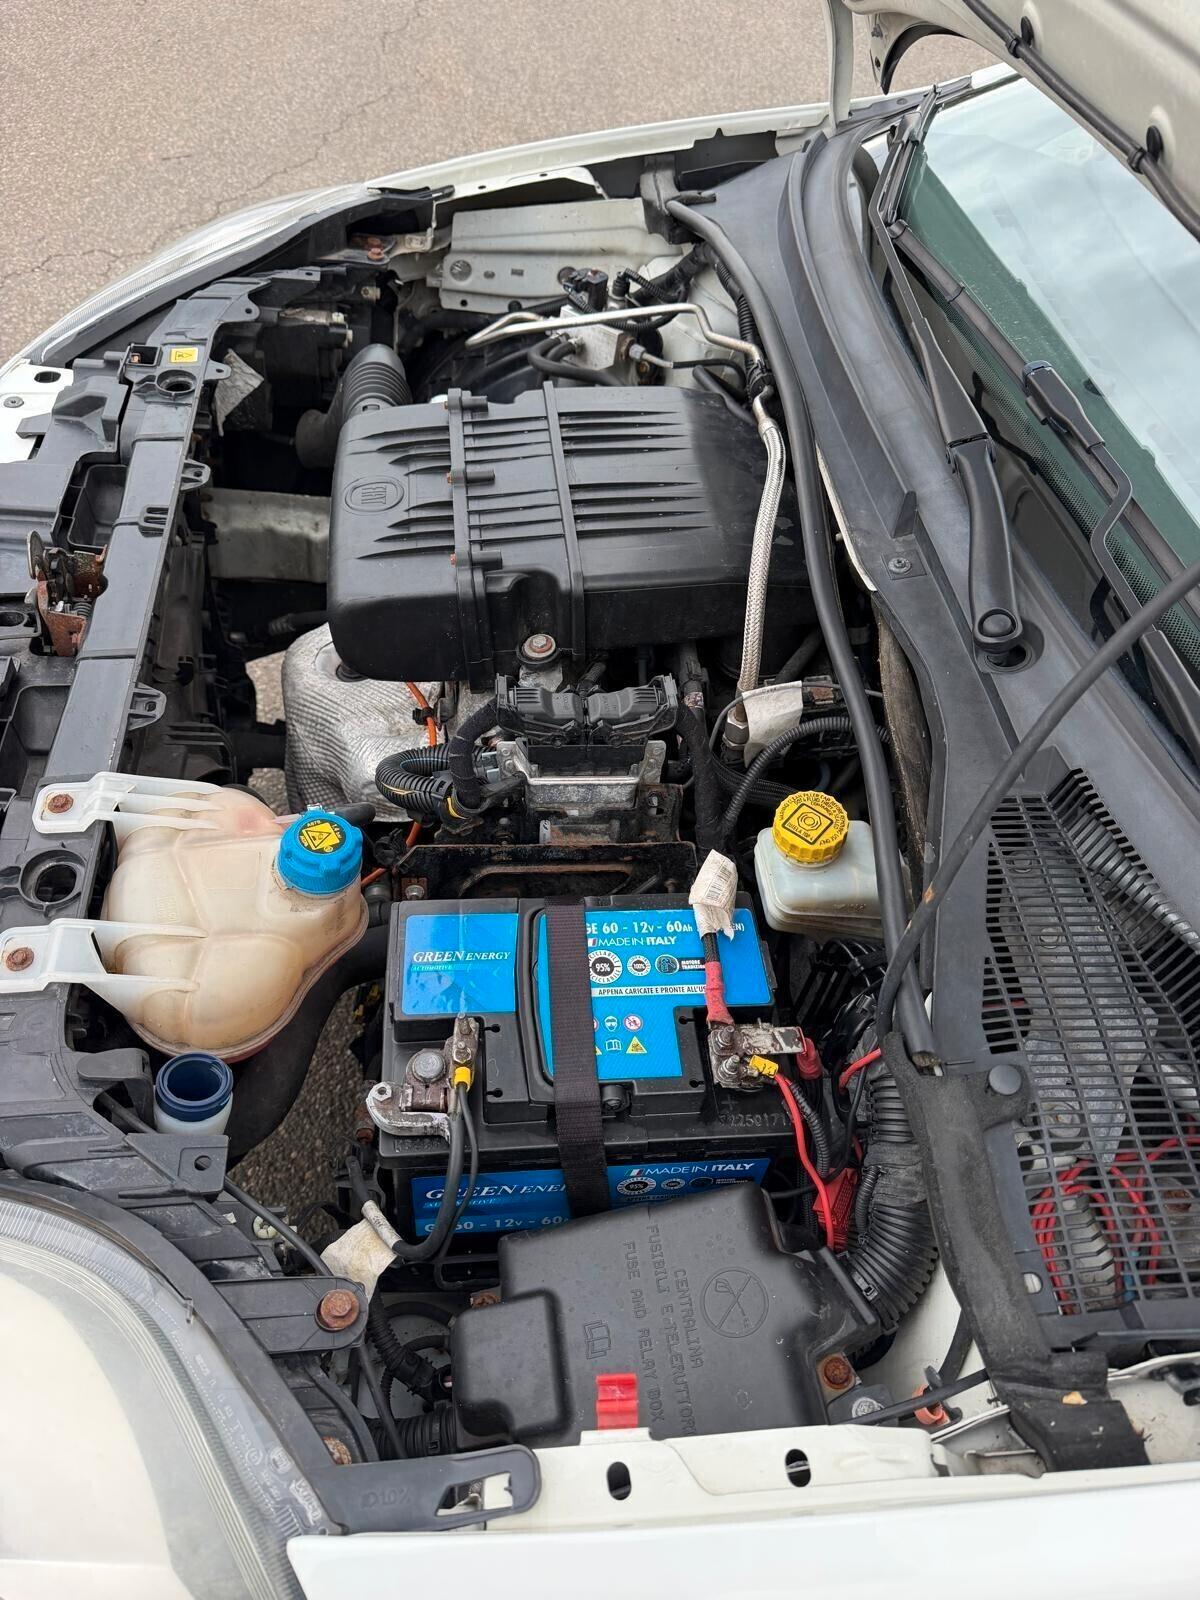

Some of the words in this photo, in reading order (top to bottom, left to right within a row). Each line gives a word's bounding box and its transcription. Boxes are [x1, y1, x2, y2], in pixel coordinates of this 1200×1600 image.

[602, 922, 619, 934] 60
[666, 920, 693, 933] 60Ah
[598, 937, 632, 947] MADE
[631, 936, 644, 947] IN
[646, 936, 677, 946] ITALY
[413, 950, 465, 963] GREEN
[465, 951, 511, 961] ENERGY
[595, 963, 611, 972] 95%
[598, 988, 624, 996] APPENA
[624, 987, 654, 995] CARICATE
[655, 986, 660, 995] E
[660, 986, 685, 995] PRONTE
[644, 1167, 690, 1176] MADE
[691, 1165, 708, 1173] IN
[711, 1162, 756, 1172] ITALY
[622, 1239, 641, 1280] FUSE
[645, 1224, 671, 1294] FUSIBILI
[661, 1303, 674, 1316] E
[630, 1287, 647, 1320] AND
[673, 1268, 705, 1369] CENTRALINA
[639, 1327, 659, 1380] RELAY
[647, 1386, 665, 1423] BOX
